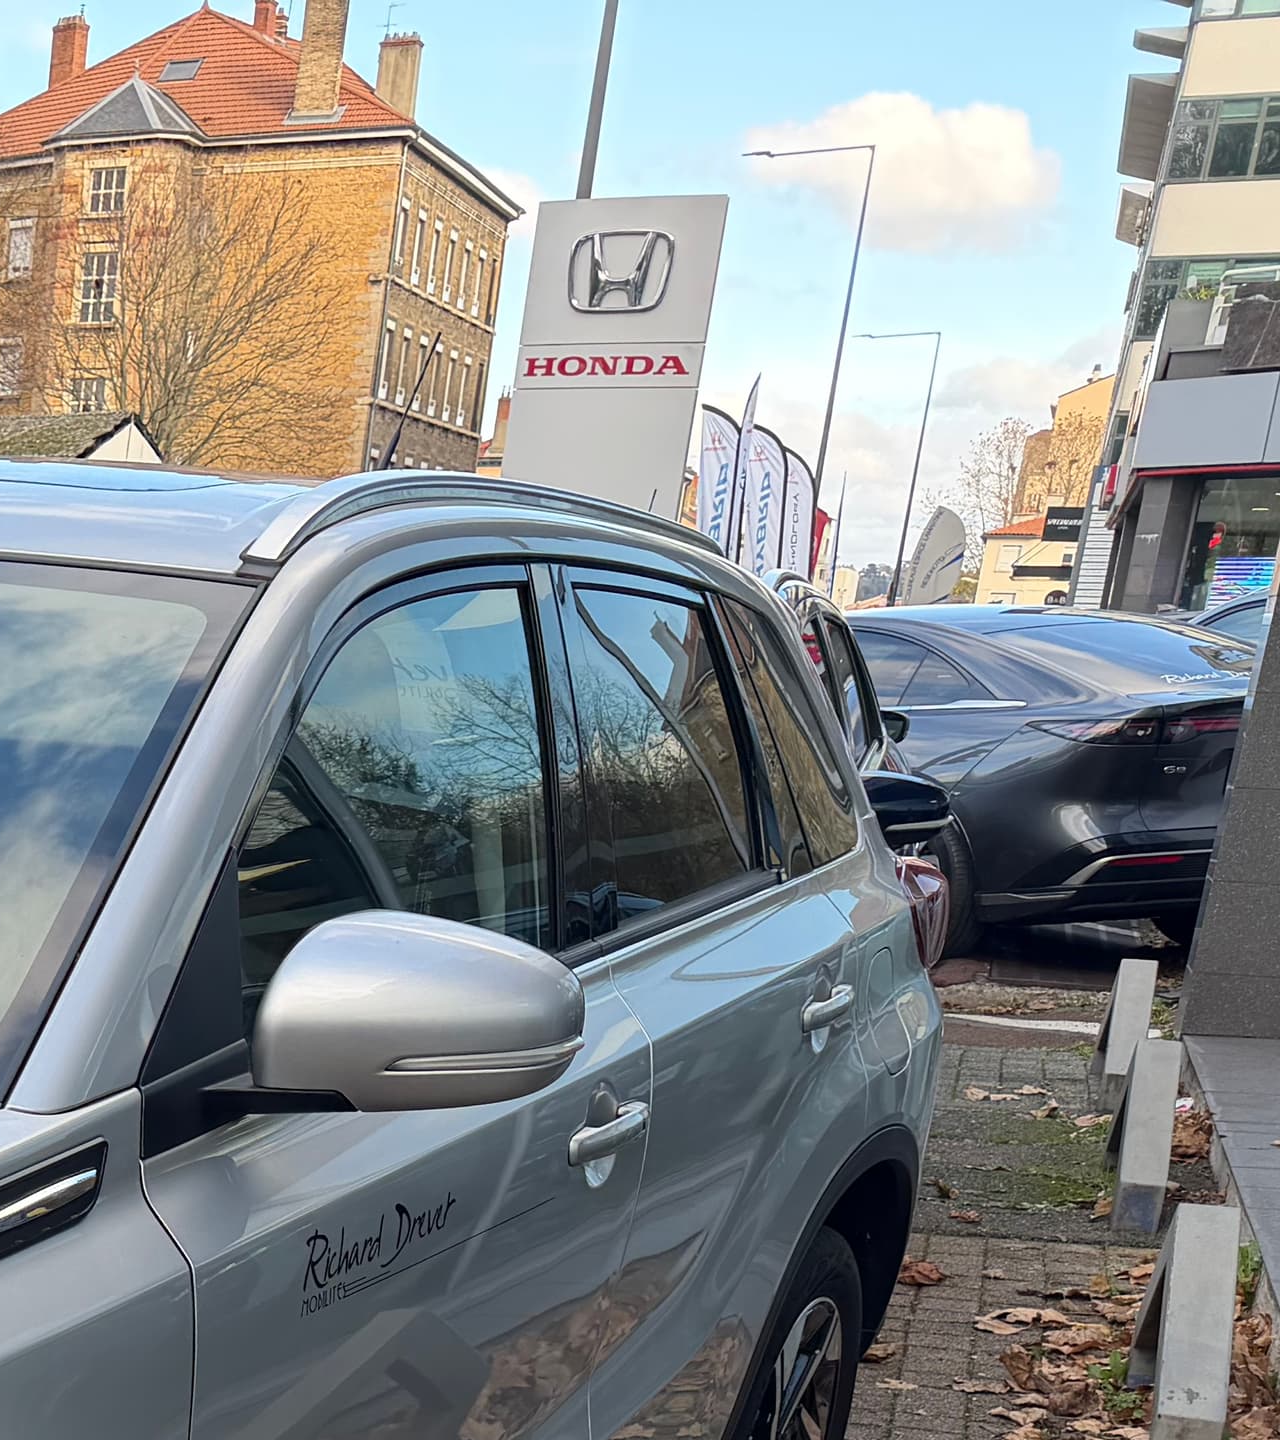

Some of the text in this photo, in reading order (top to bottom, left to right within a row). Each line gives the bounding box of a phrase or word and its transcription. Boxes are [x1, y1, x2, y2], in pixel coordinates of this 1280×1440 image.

[522, 355, 690, 377] HONDA
[303, 1191, 456, 1292] Richard Drevet
